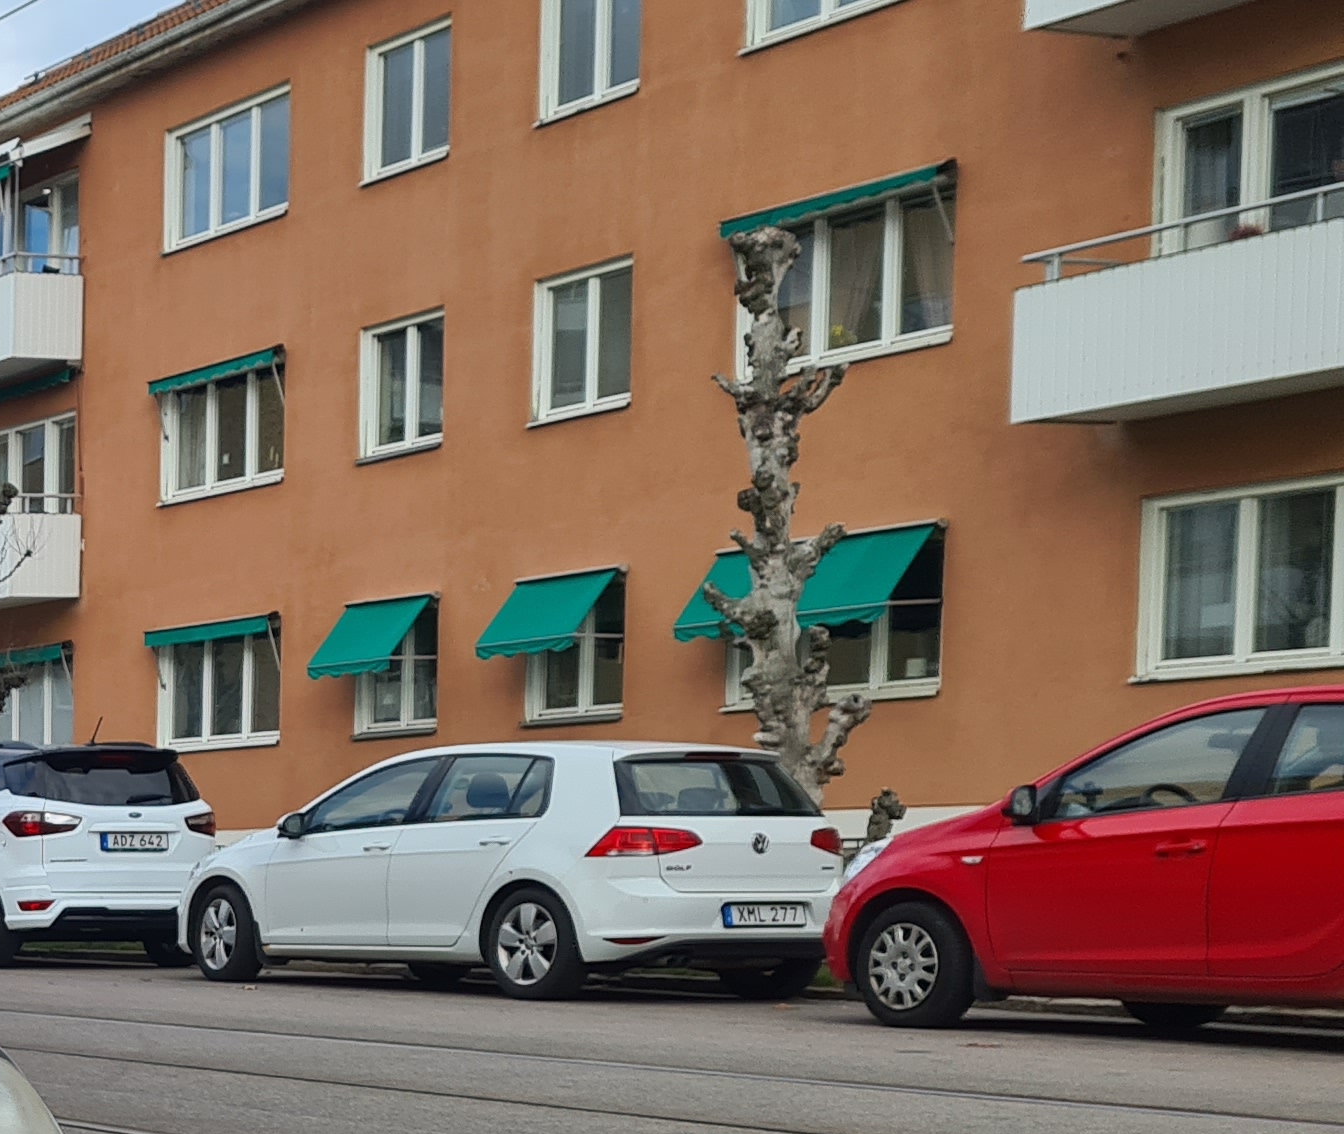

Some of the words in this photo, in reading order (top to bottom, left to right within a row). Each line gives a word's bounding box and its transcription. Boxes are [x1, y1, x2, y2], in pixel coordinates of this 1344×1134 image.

[112, 834, 136, 847] ADZ
[139, 835, 163, 847] 642
[738, 906, 766, 923] XML
[770, 906, 798, 922] 277
